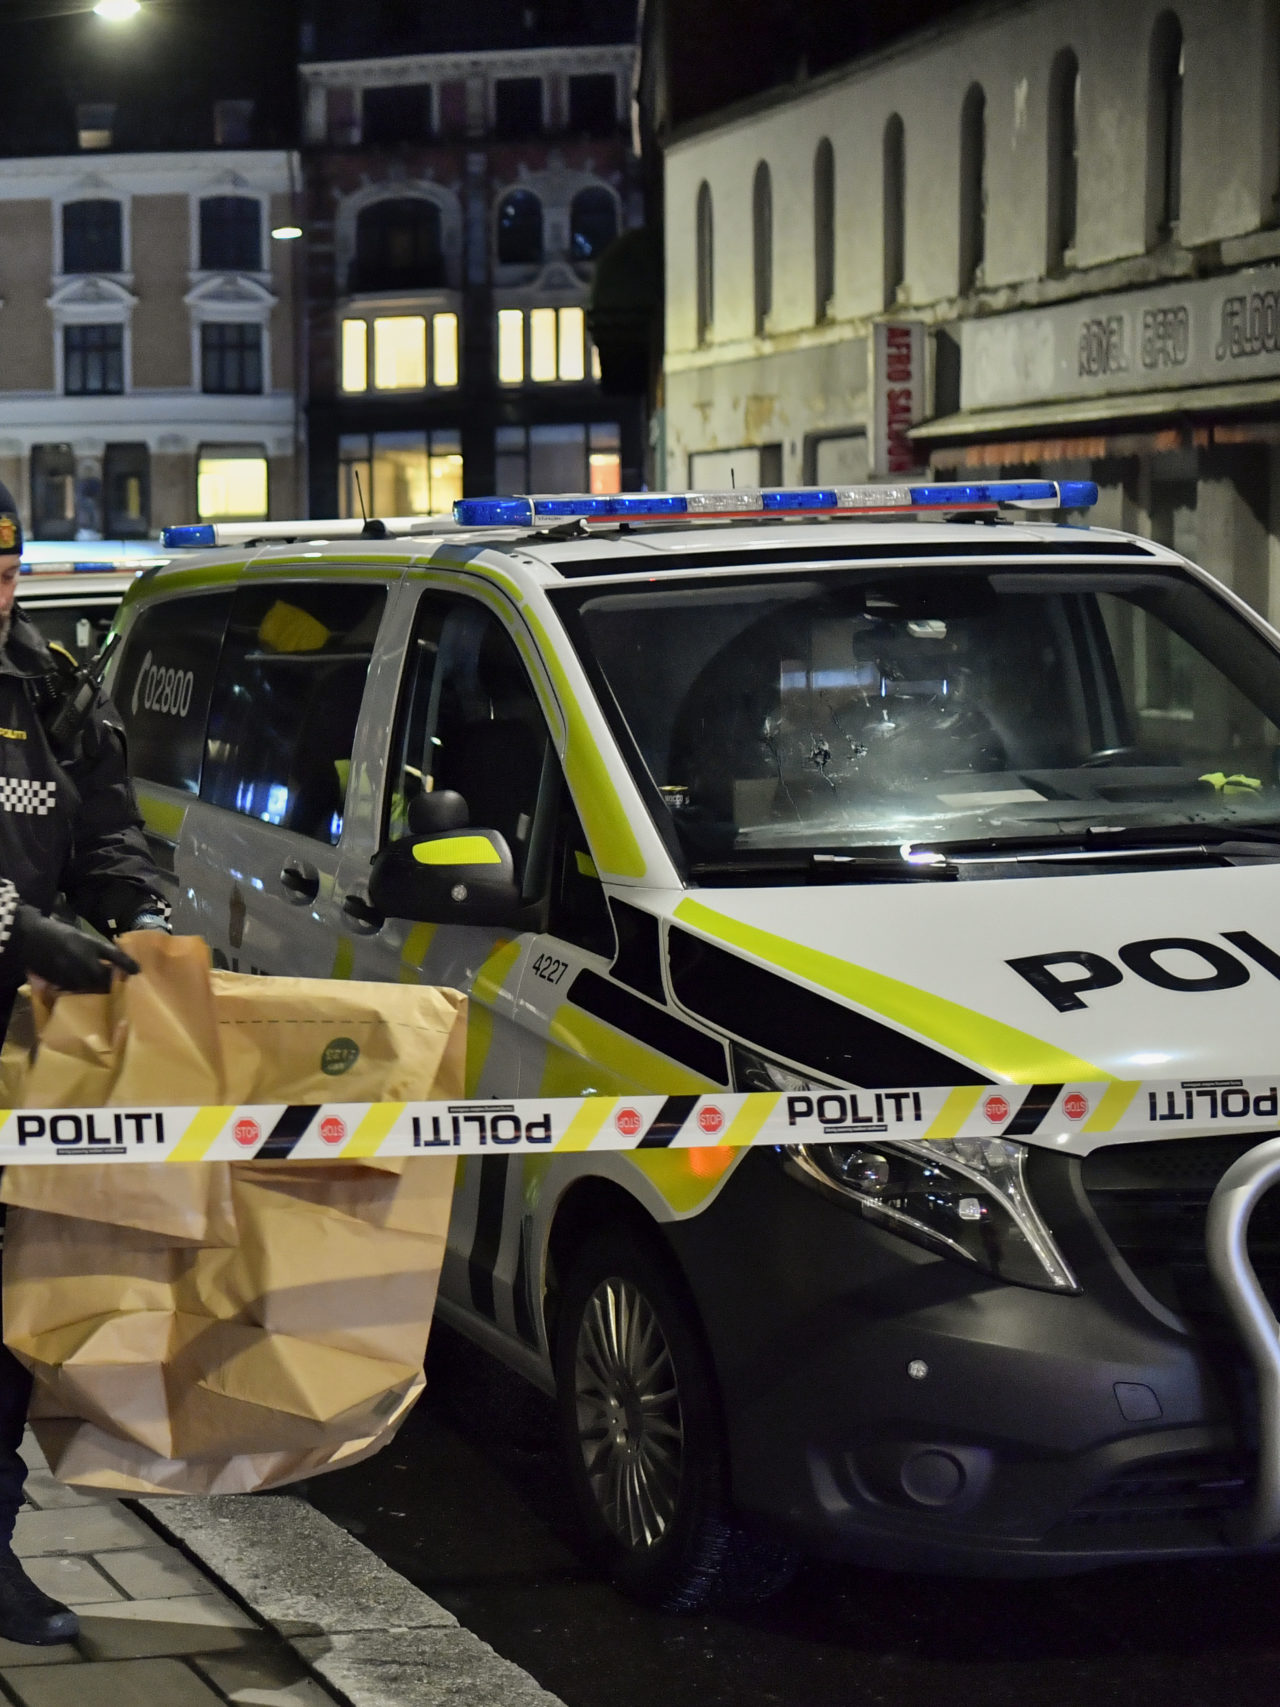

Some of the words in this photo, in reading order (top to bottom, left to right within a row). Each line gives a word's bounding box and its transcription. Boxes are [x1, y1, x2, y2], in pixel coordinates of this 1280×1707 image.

[887, 328, 912, 382] AFRO
[144, 664, 194, 717] 02800
[532, 953, 569, 985] 4227
[699, 1114, 723, 1125] STOP
[787, 1091, 922, 1125] POLITI
[985, 1103, 1008, 1114] STOP
[1065, 1100, 1088, 1111] STOP
[1148, 1087, 1279, 1121] POLITI
[17, 1112, 165, 1147] POLITI
[234, 1125, 259, 1136] STOP
[321, 1124, 346, 1136] STOP
[412, 1113, 552, 1147] POLITI
[617, 1116, 641, 1128] STOP
